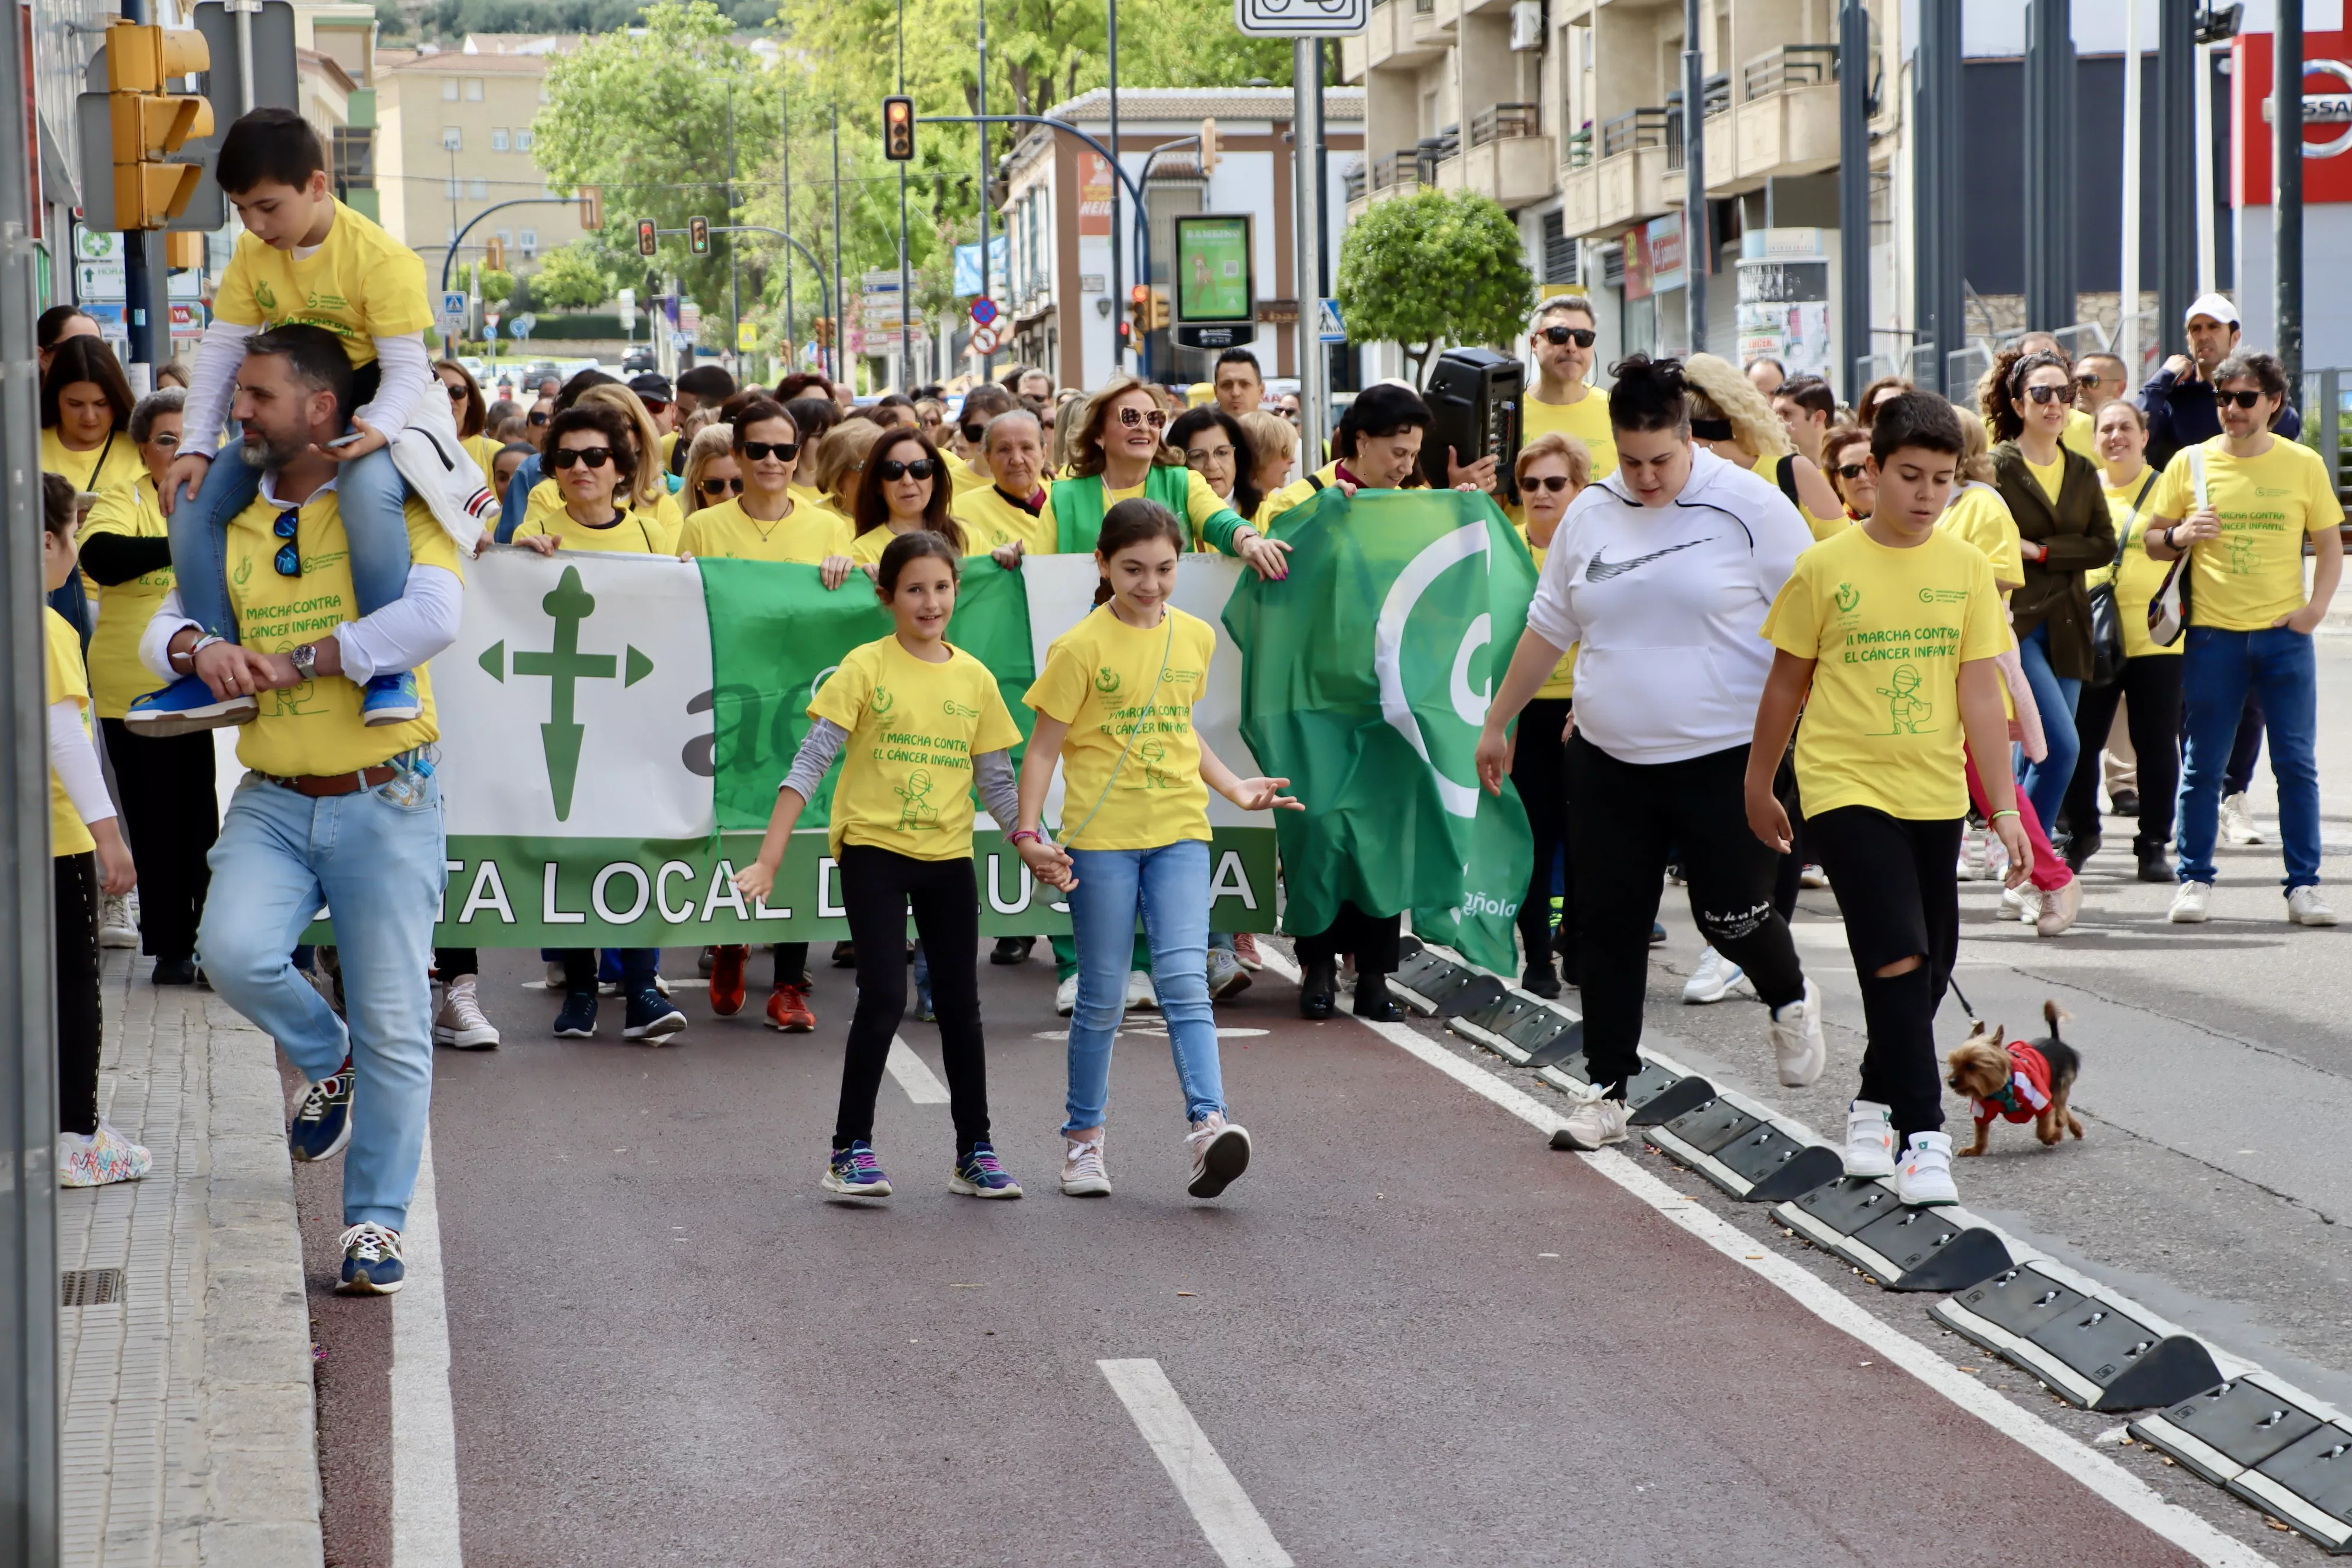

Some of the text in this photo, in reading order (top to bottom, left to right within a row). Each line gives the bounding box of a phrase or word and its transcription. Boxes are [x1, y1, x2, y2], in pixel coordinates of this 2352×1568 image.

[2303, 101, 2352, 115] SSA
[2218, 511, 2285, 520] ARCHA CONTRA
[2249, 522, 2285, 531] INFANTIL
[293, 594, 342, 614] CONTRA
[1857, 629, 1911, 645] MARCHA
[1915, 627, 1959, 640] CONTRA
[1844, 645, 1955, 664] EL CÁNCER INFANTIL
[1159, 705, 1190, 718] CONTRA
[1101, 724, 1113, 736] EL
[1116, 721, 1155, 736] CÁNCER
[887, 733, 931, 747] MARCHA
[874, 747, 971, 770] EL CÁNCER INFANTIL
[542, 858, 793, 926] LOCAL
